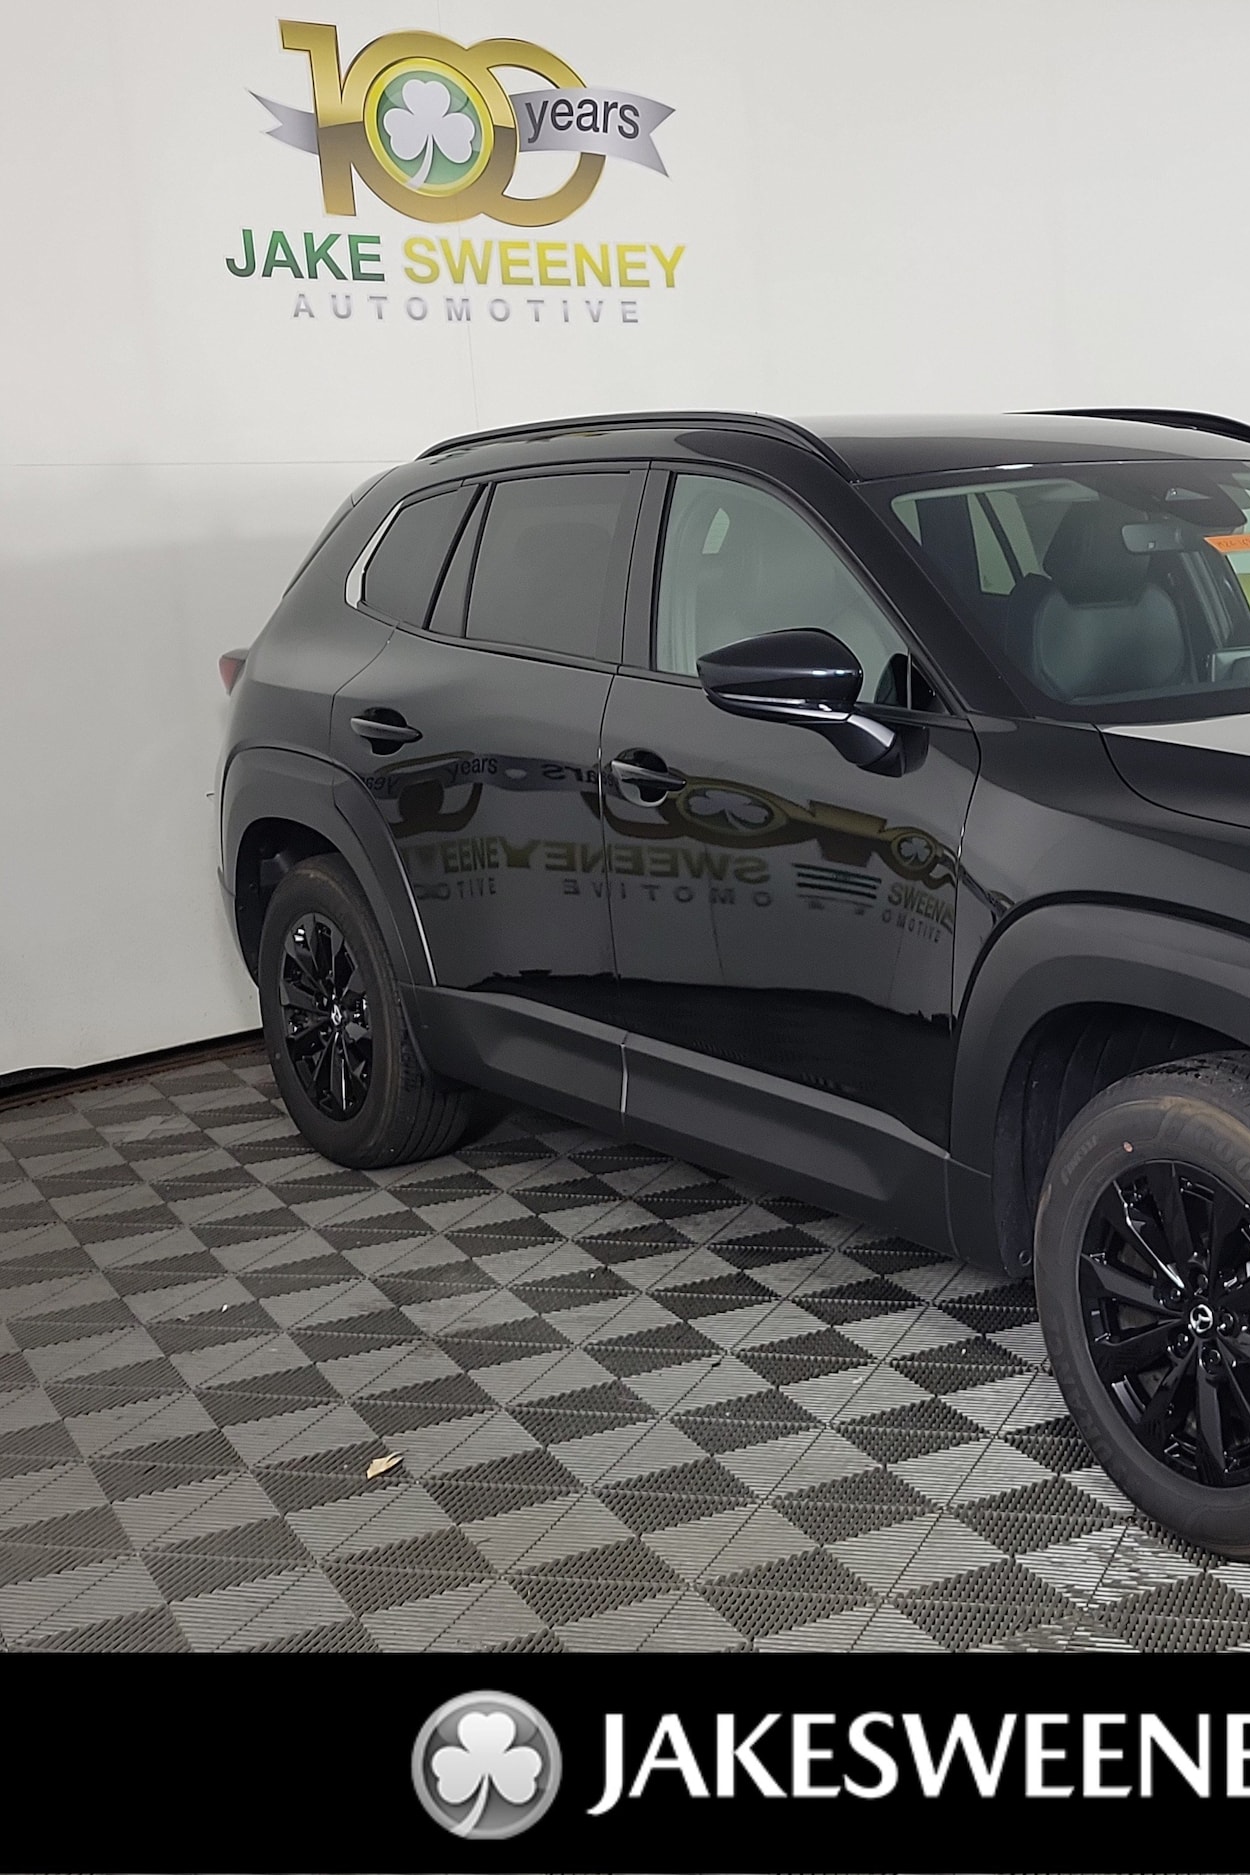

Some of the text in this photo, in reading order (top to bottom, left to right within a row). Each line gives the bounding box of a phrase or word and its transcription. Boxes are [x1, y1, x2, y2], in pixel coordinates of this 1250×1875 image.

[278, 19, 641, 228] 100 years
[226, 229, 686, 289] JAKE SWEENEY
[293, 294, 640, 324] AUTOMOTIVE
